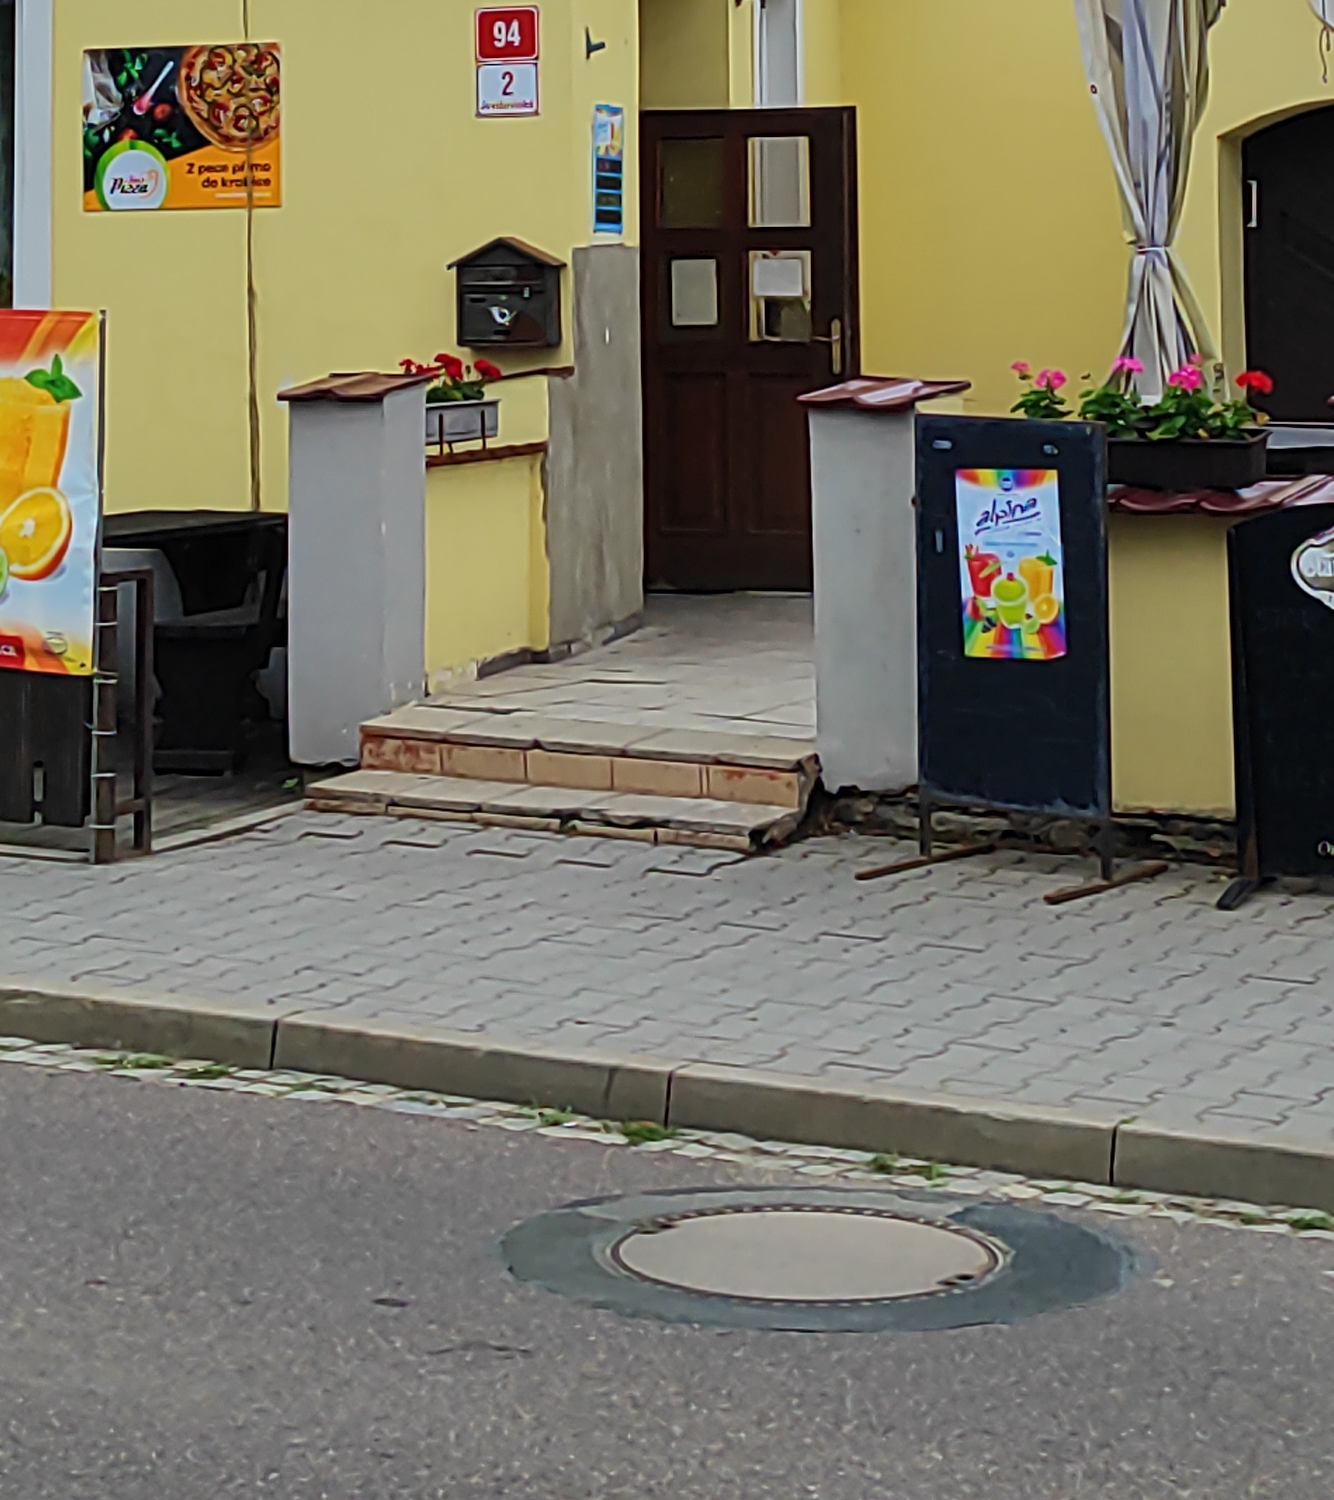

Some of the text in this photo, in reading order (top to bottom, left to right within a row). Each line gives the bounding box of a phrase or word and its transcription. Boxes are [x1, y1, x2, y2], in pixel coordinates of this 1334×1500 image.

[493, 18, 521, 48] 94
[501, 71, 514, 96] 2
[185, 163, 195, 174] Z
[110, 177, 148, 194] Pizza
[201, 176, 218, 188] do
[975, 498, 1037, 527] alpina
